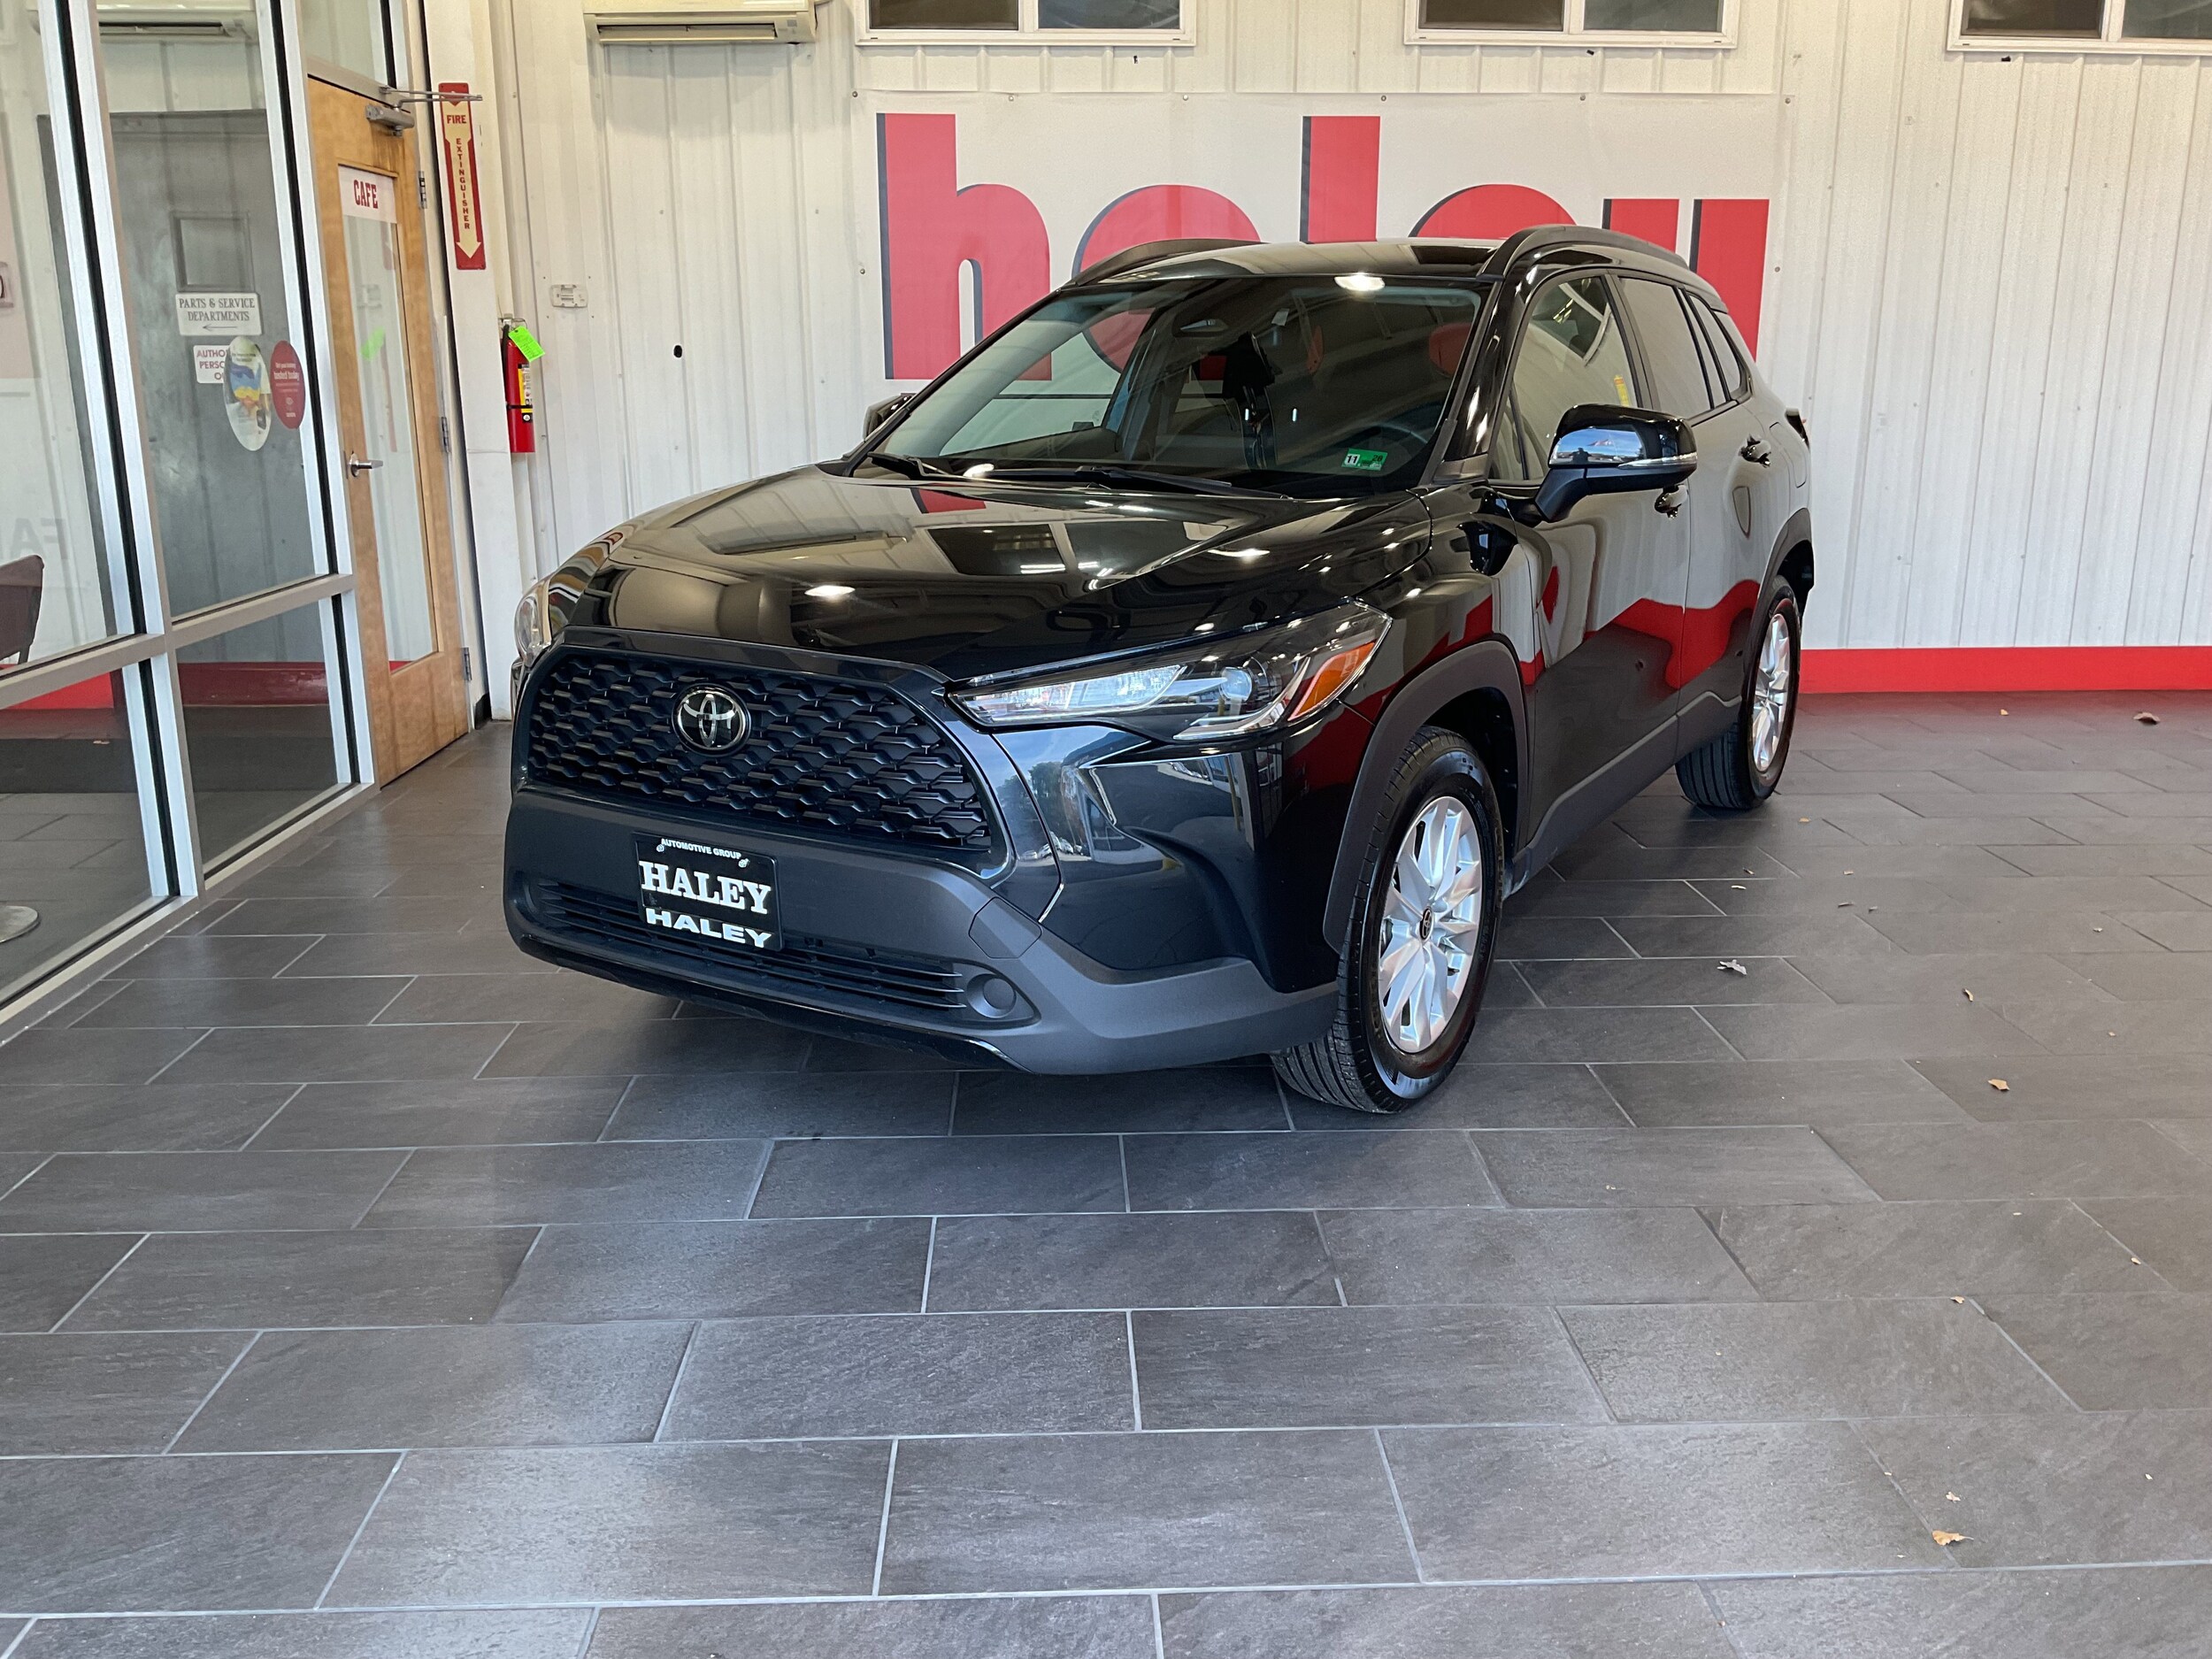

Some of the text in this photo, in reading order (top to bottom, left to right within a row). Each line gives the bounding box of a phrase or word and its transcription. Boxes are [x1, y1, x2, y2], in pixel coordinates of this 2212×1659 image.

[447, 114, 467, 125] FIRE
[456, 137, 471, 230] EXTINGUISHER
[353, 179, 379, 210] CAFE
[179, 297, 256, 309] PARTS & SERVICE
[188, 311, 250, 321] DEPARTMENTS
[196, 349, 227, 357] AUTHO
[199, 360, 226, 370] PERSO
[1347, 454, 1359, 464] 11
[661, 838, 742, 860] AUTOMOTIVE GROUP
[638, 860, 772, 915] HALEY
[645, 907, 772, 949] HALEY
